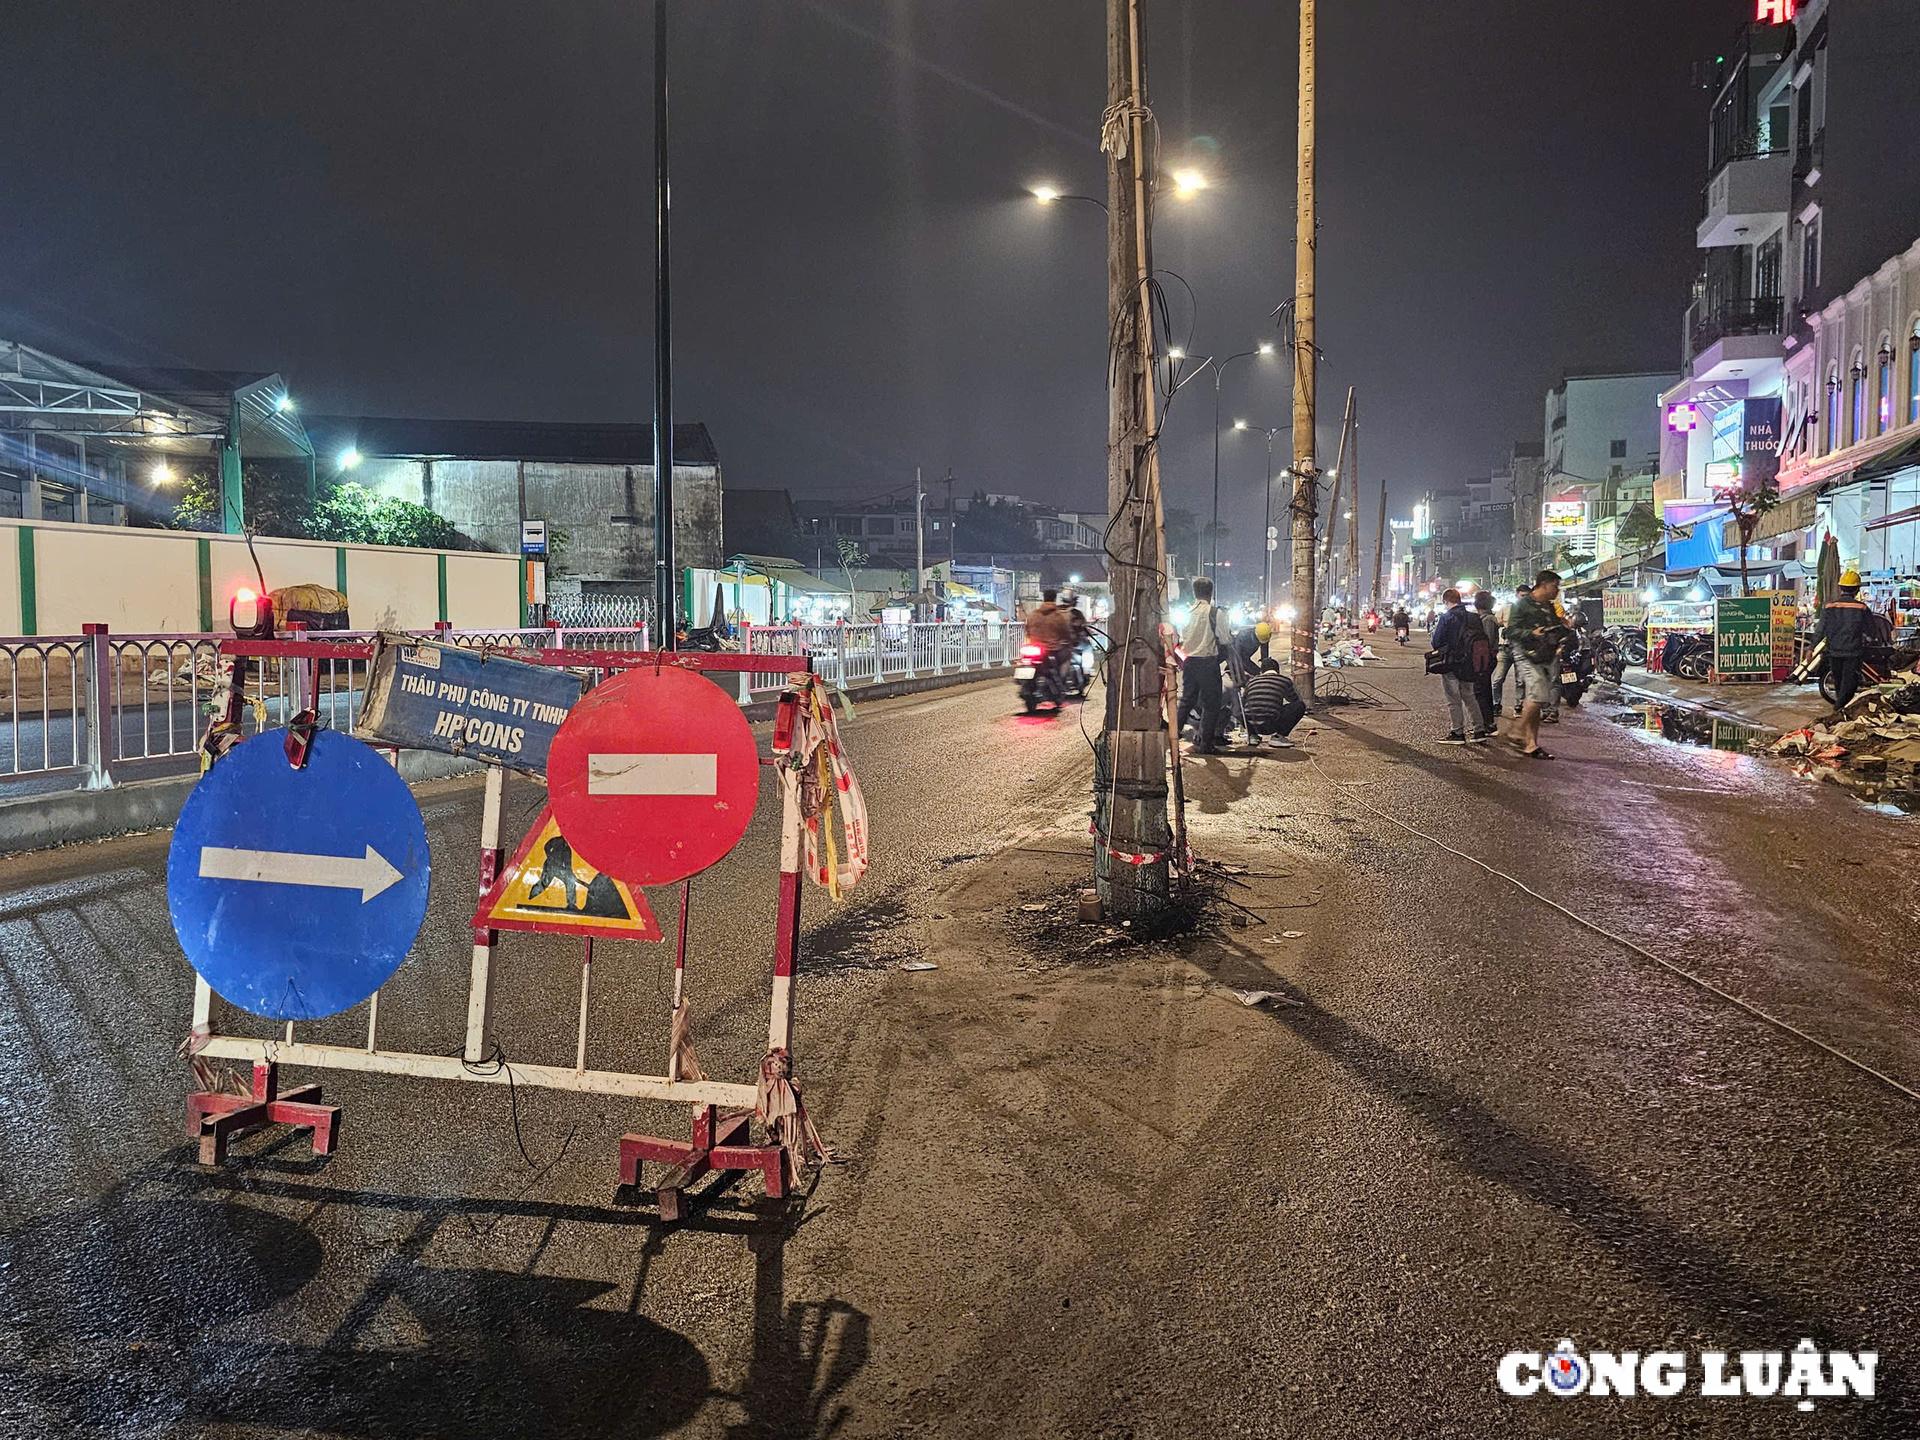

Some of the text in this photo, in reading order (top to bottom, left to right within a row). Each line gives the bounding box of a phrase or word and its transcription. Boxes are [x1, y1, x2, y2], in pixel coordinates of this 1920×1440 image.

[1749, 420, 1773, 436] NHÀ
[1744, 435, 1780, 451] THUỐC
[1719, 624, 1770, 647] MỸ PHẨM
[1719, 650, 1770, 671] PHỤ LIỆU TÓC
[400, 672, 570, 726] THẦU PHỤ CÔNG TY TNHH
